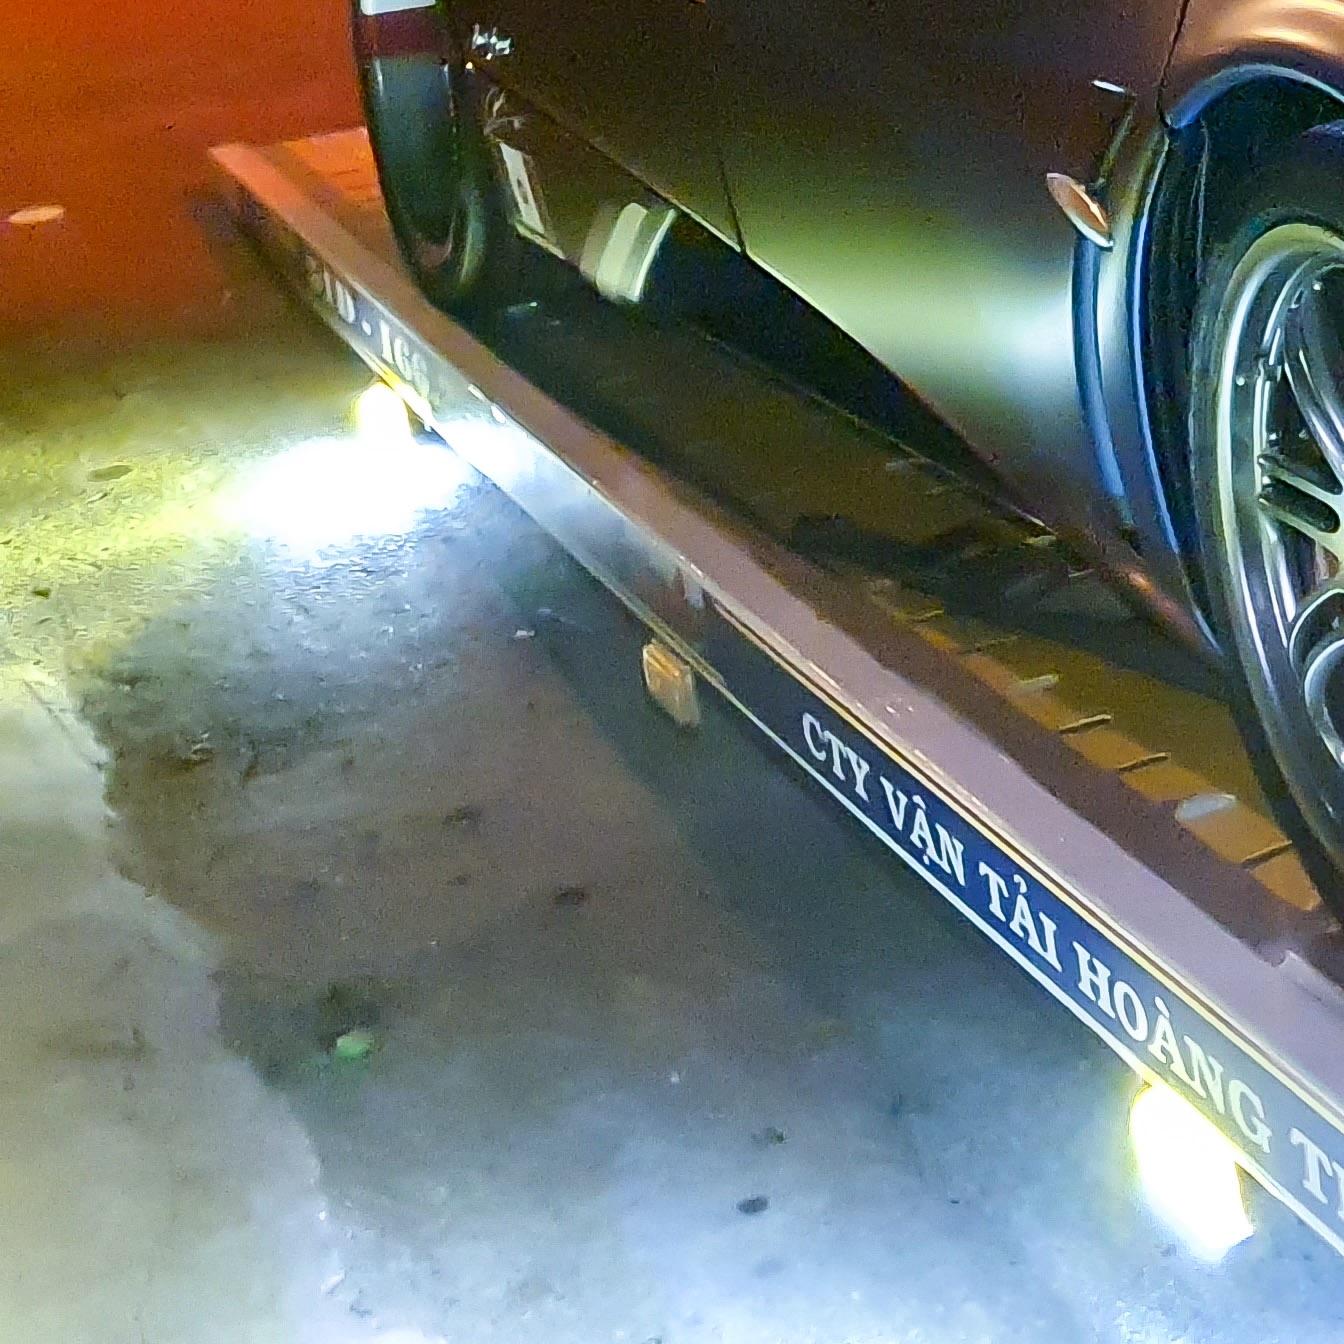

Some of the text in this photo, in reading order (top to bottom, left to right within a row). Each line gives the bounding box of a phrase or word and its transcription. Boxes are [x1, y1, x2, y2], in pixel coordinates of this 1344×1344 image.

[802, 712, 870, 802] CTY
[879, 775, 966, 887] VẬN
[1072, 940, 1273, 1154] HOÀNG
